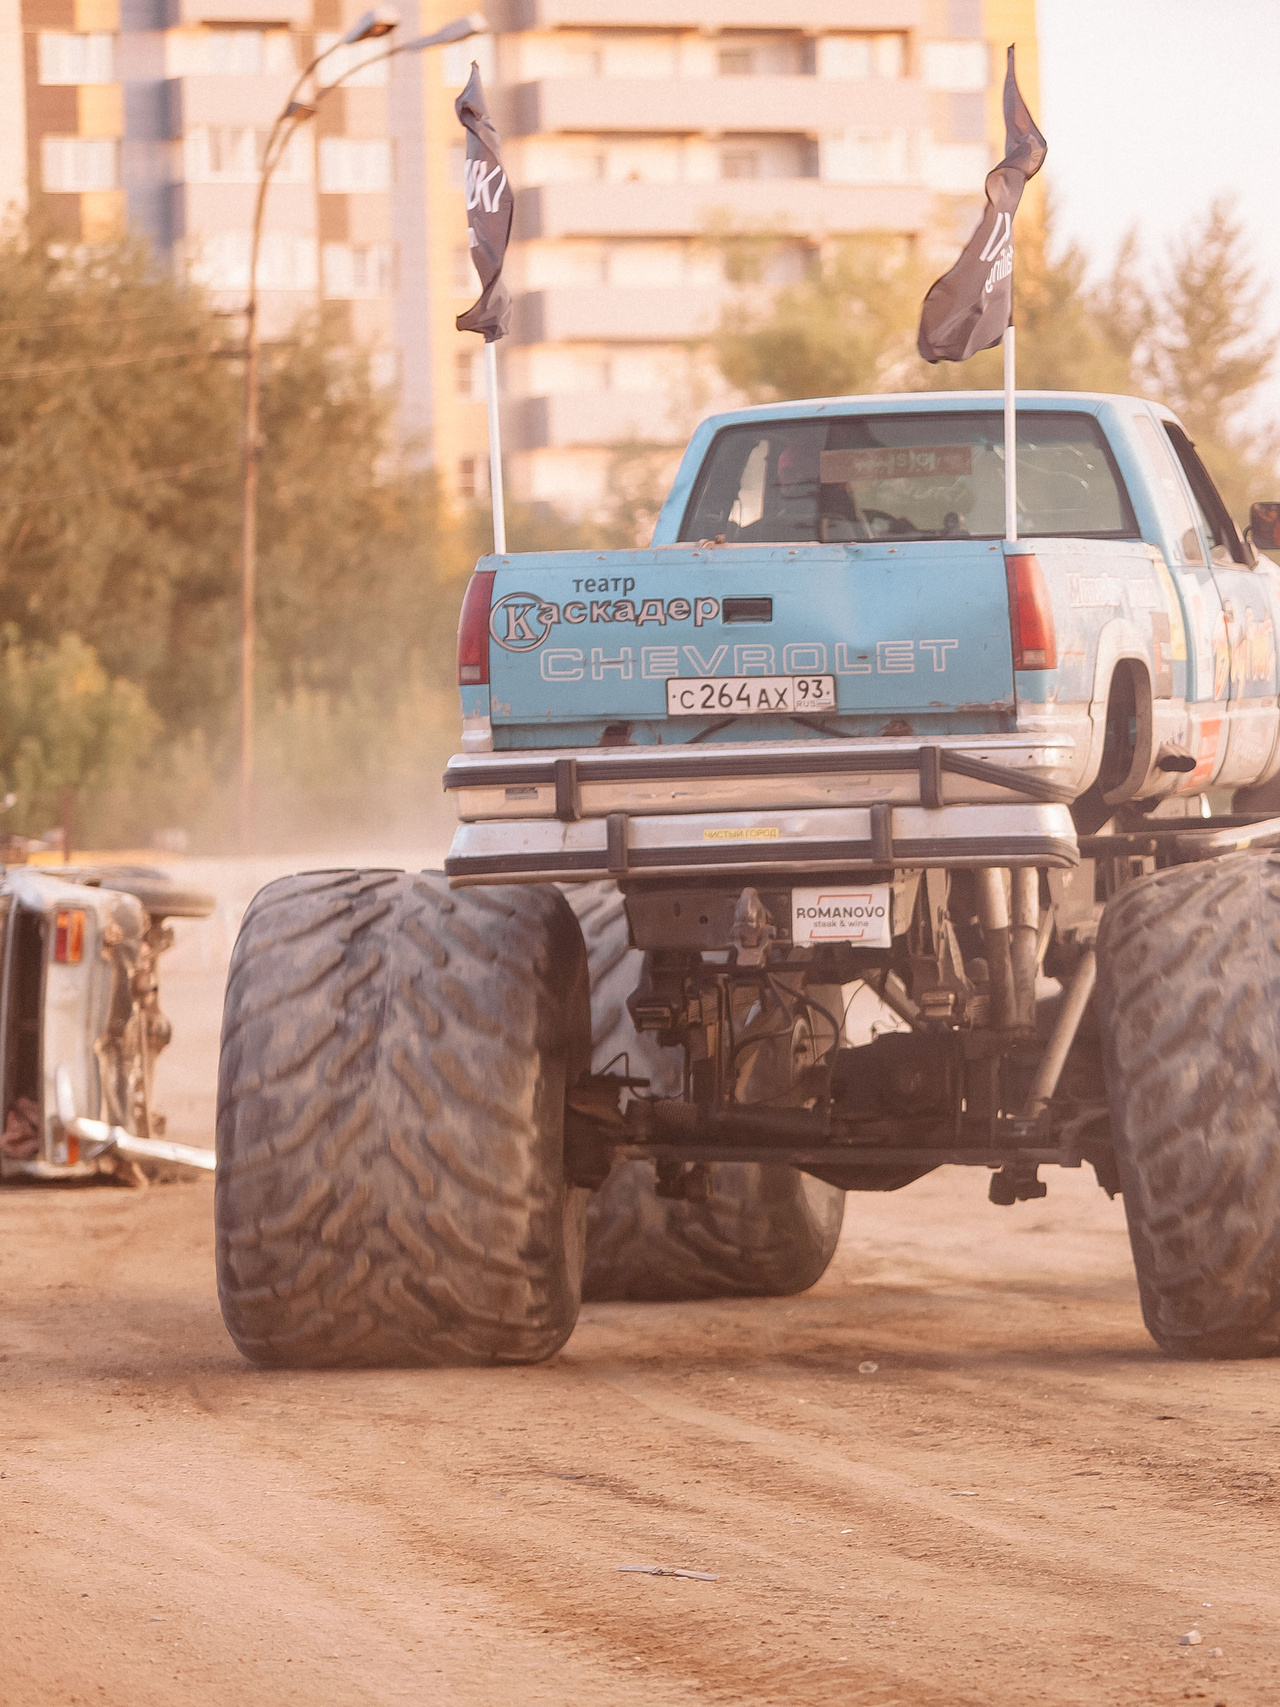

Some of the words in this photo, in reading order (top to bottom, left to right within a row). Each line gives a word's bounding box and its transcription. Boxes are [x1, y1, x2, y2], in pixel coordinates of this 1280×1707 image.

[572, 577, 636, 596] театр
[502, 596, 721, 642] Каскадер
[540, 639, 959, 681] CHEVROLET
[796, 906, 885, 918] ROMANOVO
[813, 920, 836, 928] steak
